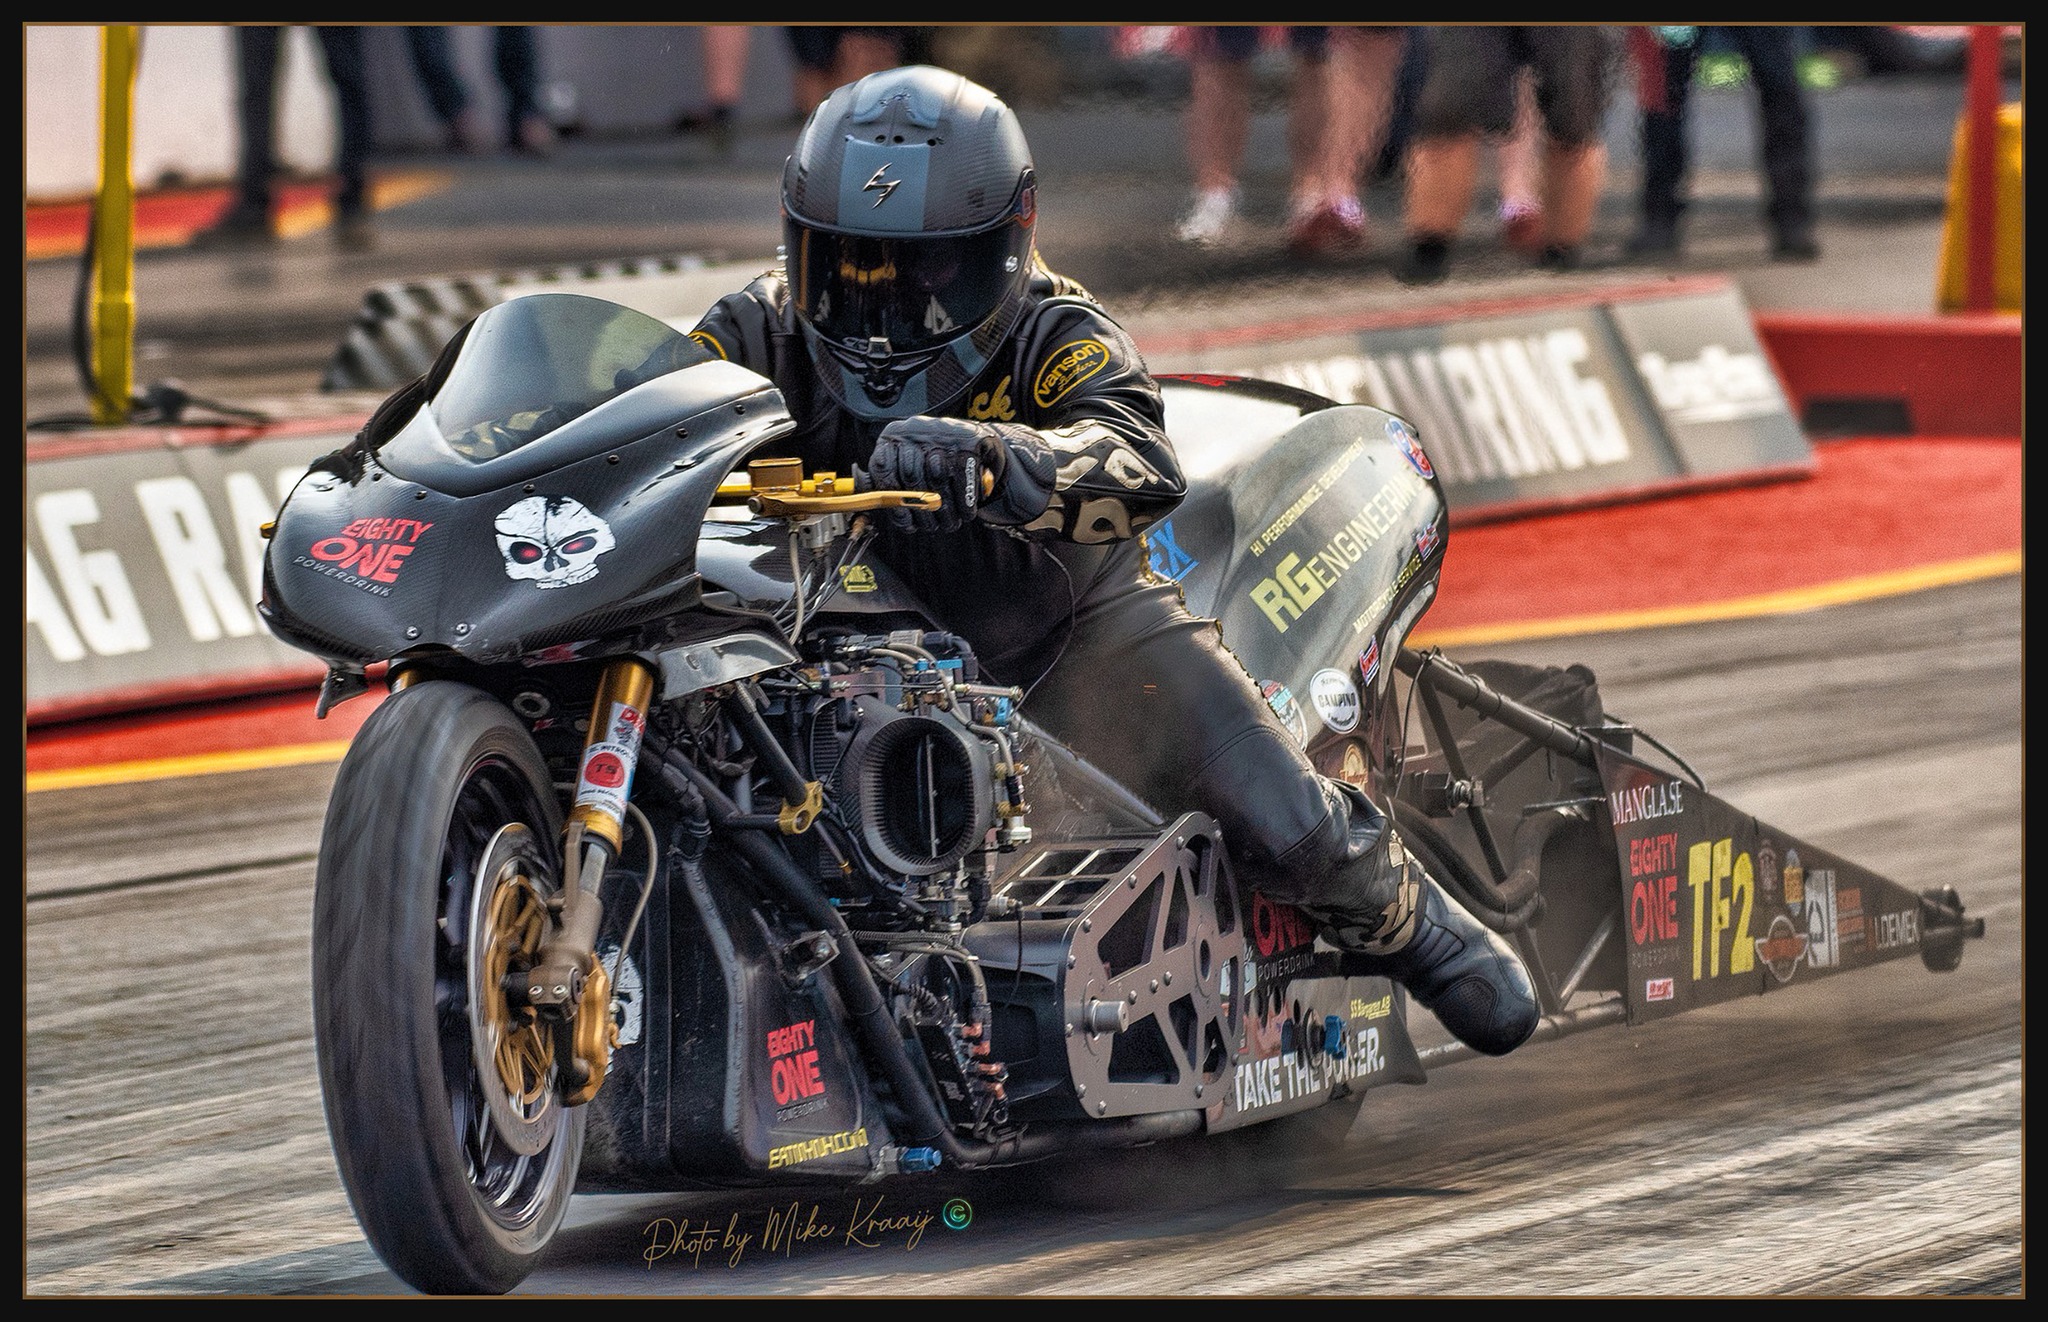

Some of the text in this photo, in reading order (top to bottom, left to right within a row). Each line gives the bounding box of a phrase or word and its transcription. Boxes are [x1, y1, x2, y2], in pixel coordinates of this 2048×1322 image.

[1038, 343, 1101, 396] vanson
[340, 517, 435, 543] EIGHTY
[1250, 539, 1266, 557] HI
[1261, 484, 1324, 546] PERFORMANCE
[293, 555, 393, 597] POWERDRINK
[310, 537, 416, 584] ONE
[1630, 833, 1678, 877] EIGHTY
[1631, 875, 1679, 945] ONE
[1688, 838, 1755, 981] TF2
[767, 1019, 815, 1058] EIGHTY
[771, 1050, 826, 1106] ONE
[1234, 1056, 1283, 1112] TAKE
